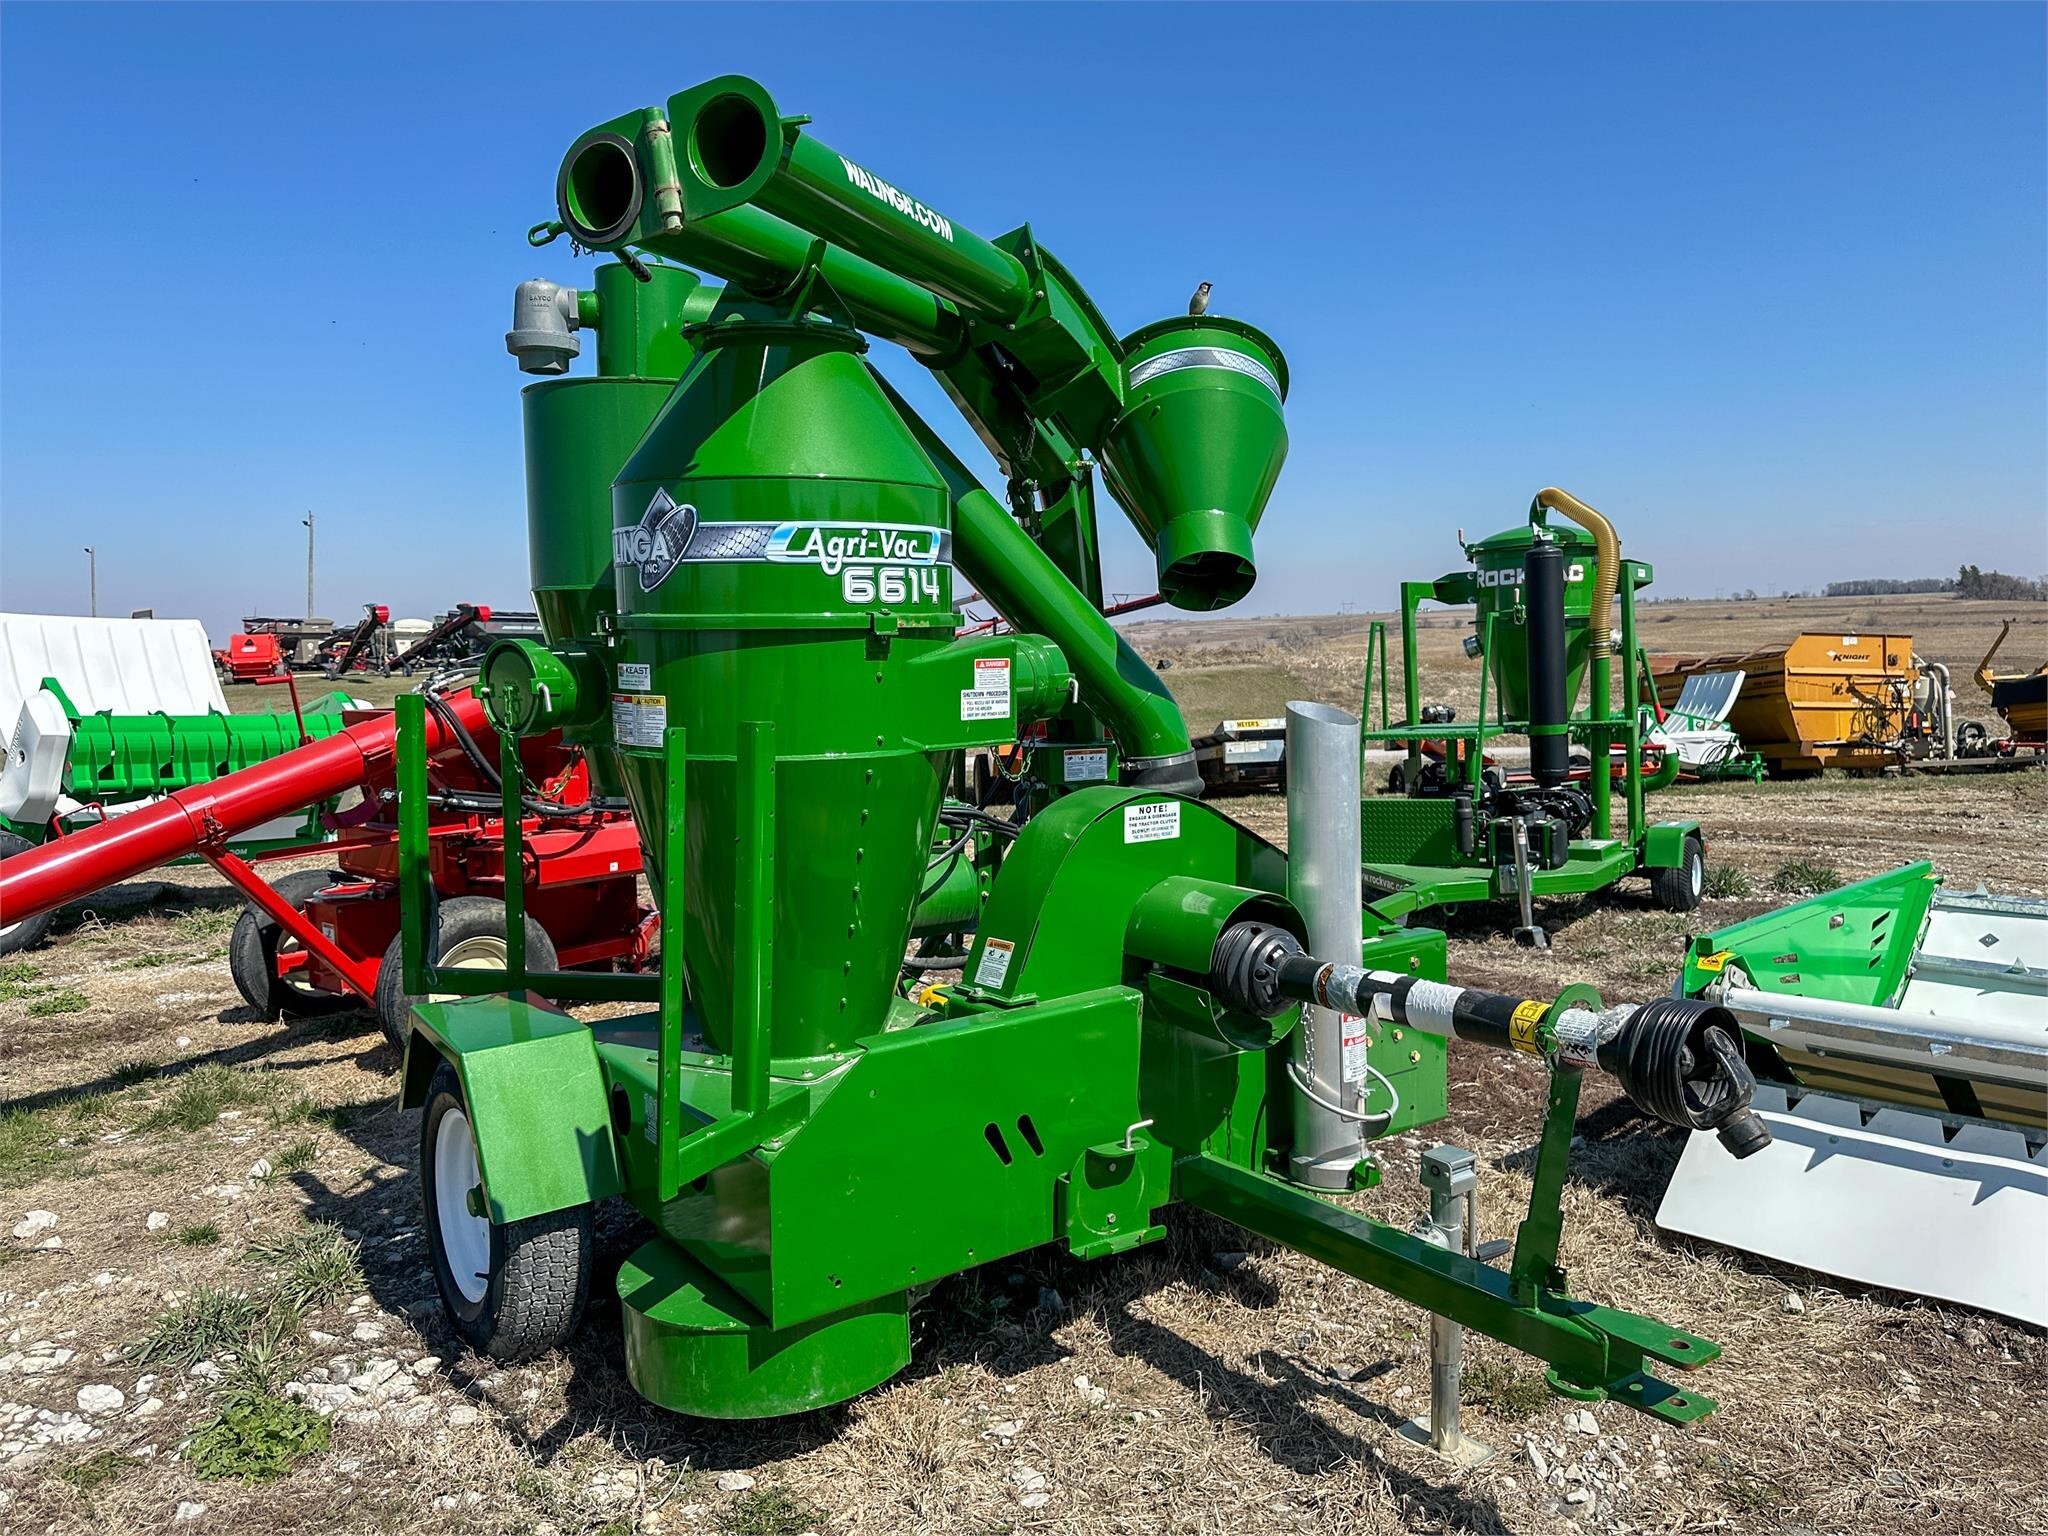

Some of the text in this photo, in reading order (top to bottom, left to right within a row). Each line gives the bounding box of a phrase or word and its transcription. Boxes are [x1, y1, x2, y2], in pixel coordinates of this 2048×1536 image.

[838, 155, 953, 243] WALINGA.COM
[614, 527, 671, 563] LINGA
[804, 528, 919, 576] Agri-Vac
[644, 563, 660, 574] INC.
[1477, 564, 1584, 588] ROCKC
[842, 567, 940, 604] 6614
[1833, 654, 1870, 662] KNIGHT
[625, 666, 649, 675] KEAST
[1139, 805, 1168, 814] NOTE!
